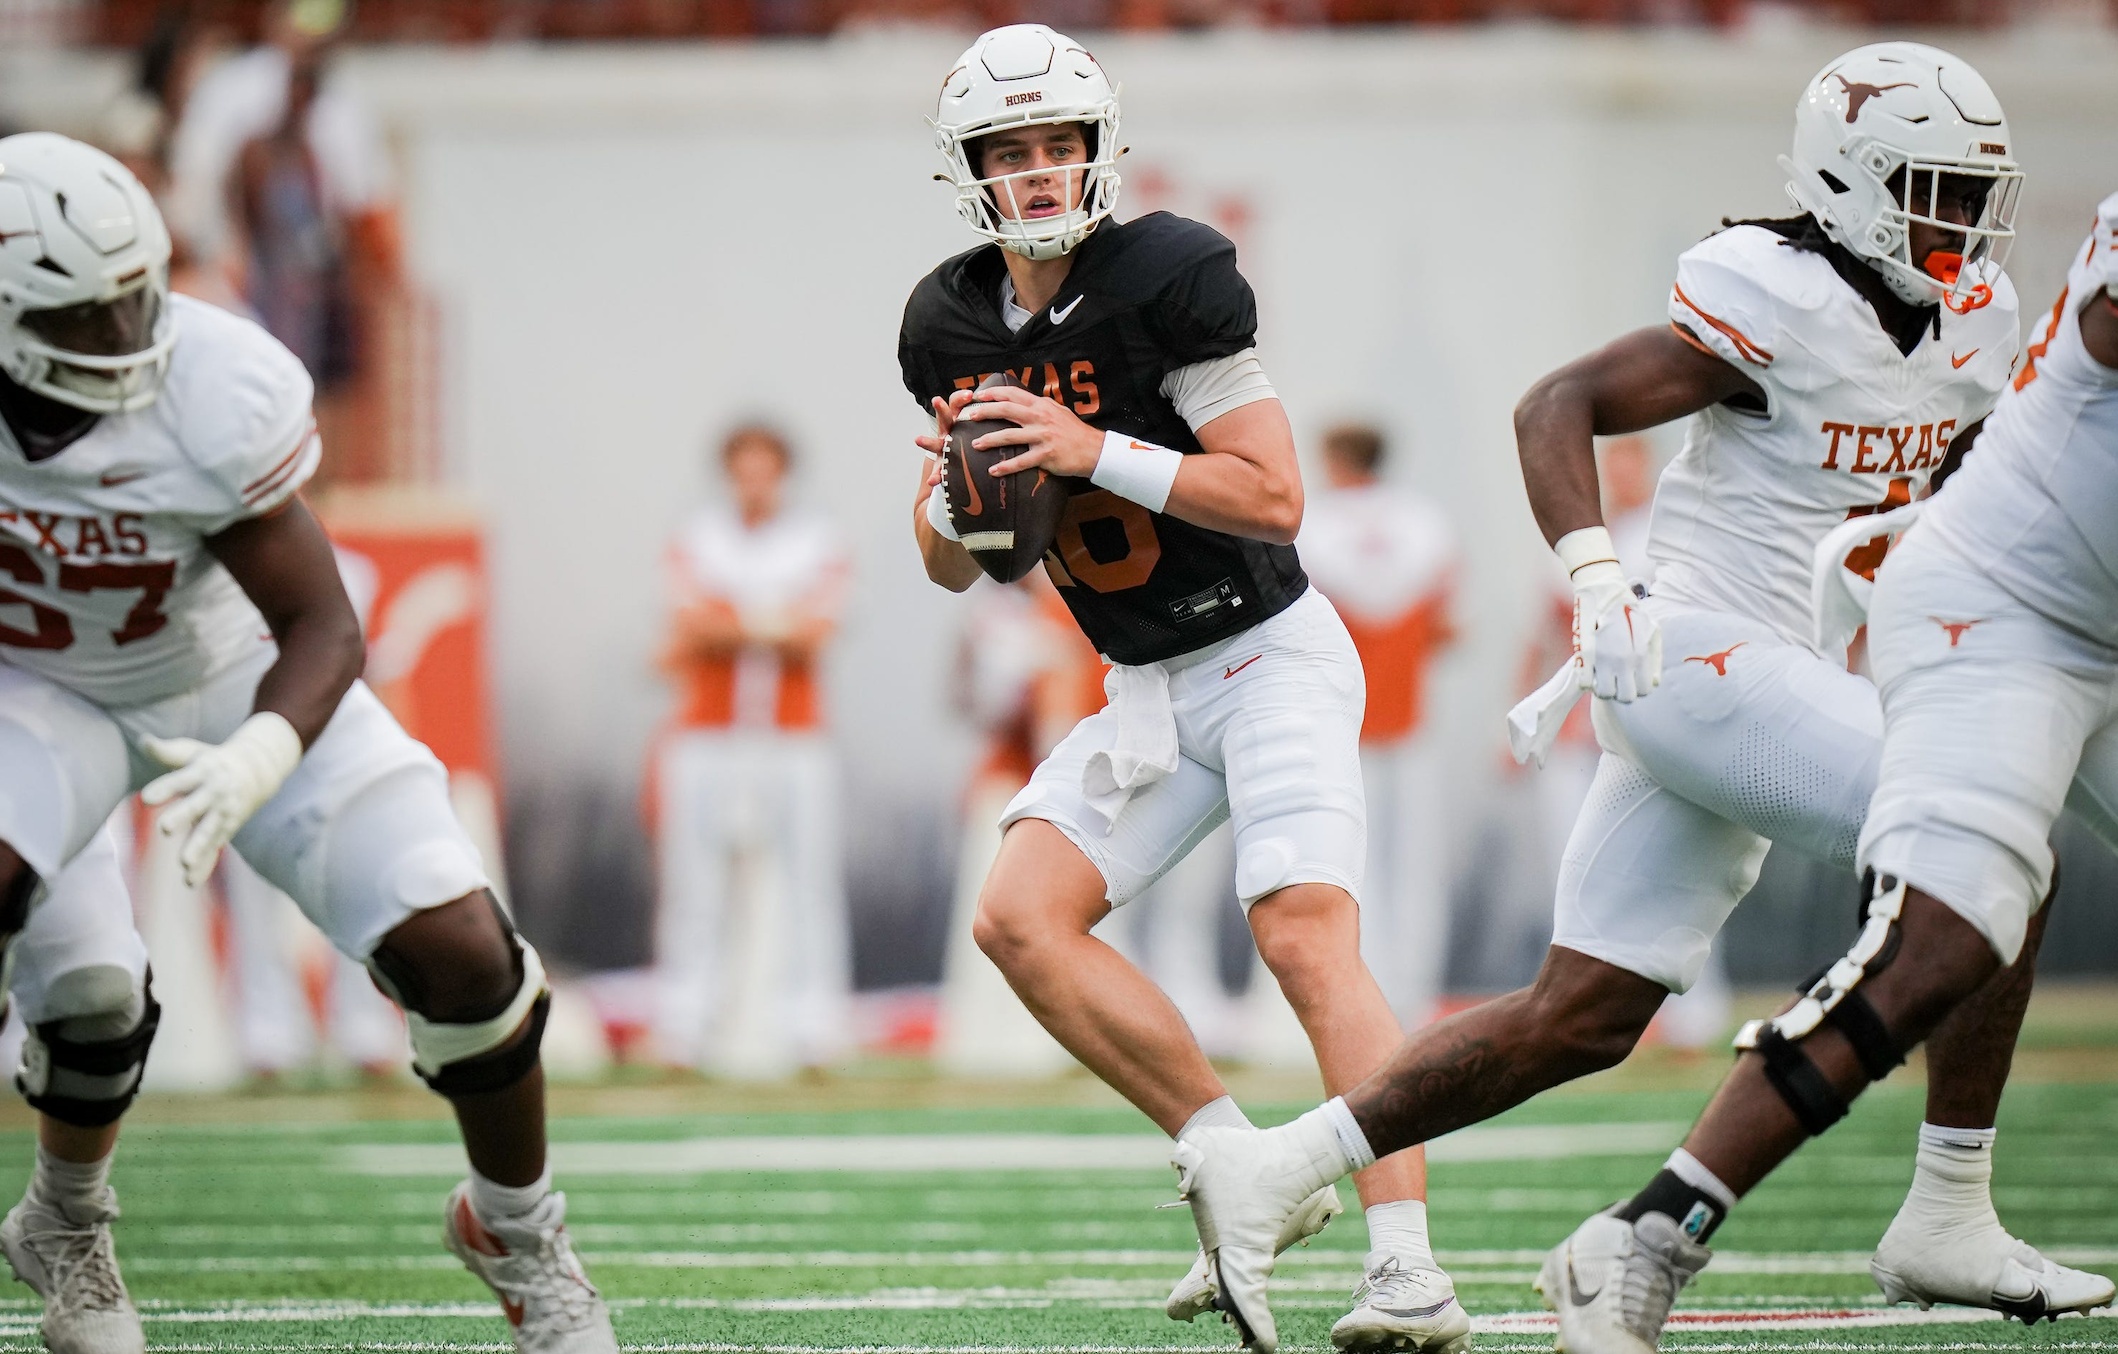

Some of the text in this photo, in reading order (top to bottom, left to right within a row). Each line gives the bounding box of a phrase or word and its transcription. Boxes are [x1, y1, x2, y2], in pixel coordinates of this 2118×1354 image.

[1005, 91, 1042, 106] HORNS
[953, 360, 1100, 415] TAS
[1821, 419, 1957, 474] TEXAS
[0, 510, 148, 557] XAS
[1220, 585, 1231, 597] M
